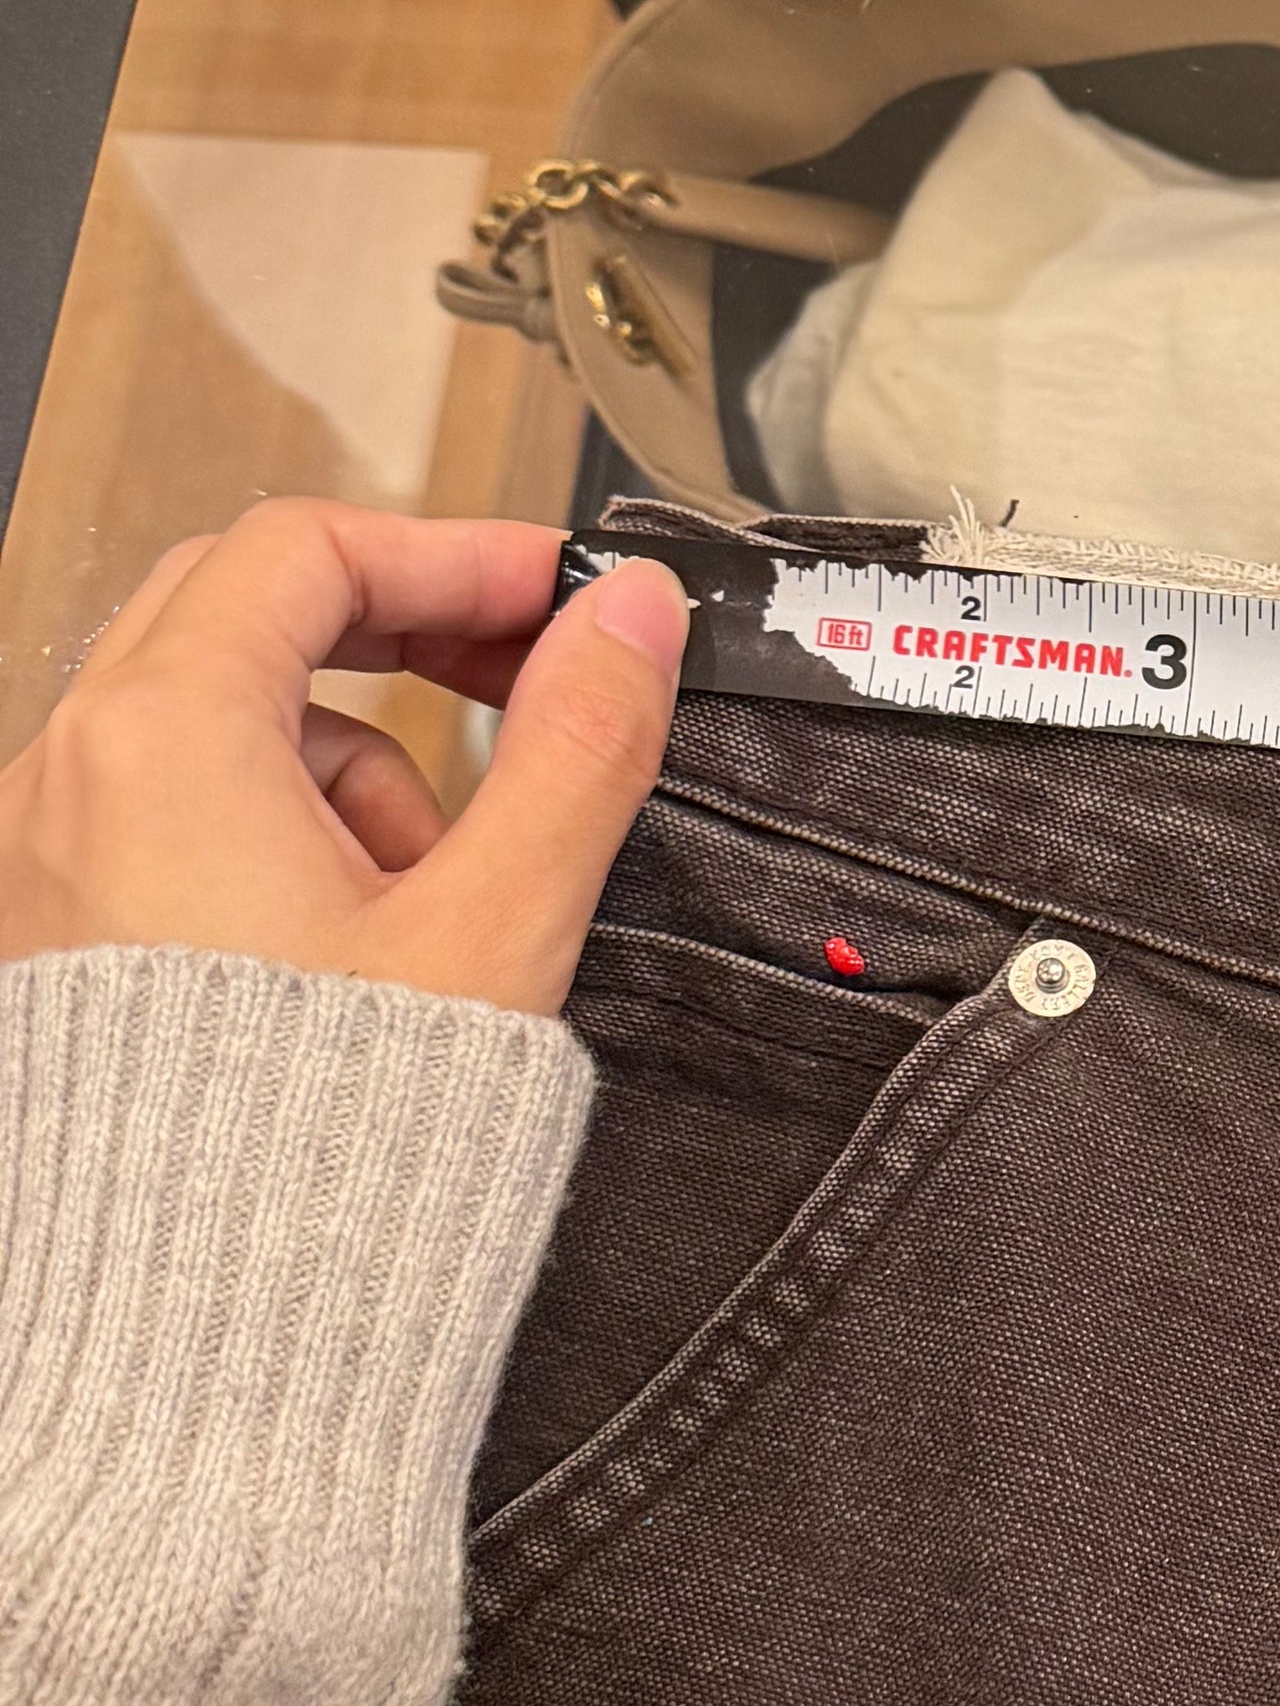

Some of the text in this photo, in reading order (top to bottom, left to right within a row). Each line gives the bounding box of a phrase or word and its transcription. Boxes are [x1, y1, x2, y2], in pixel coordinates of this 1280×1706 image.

[960, 596, 981, 621] 2
[1142, 634, 1188, 690] 3
[952, 665, 974, 689] 2
